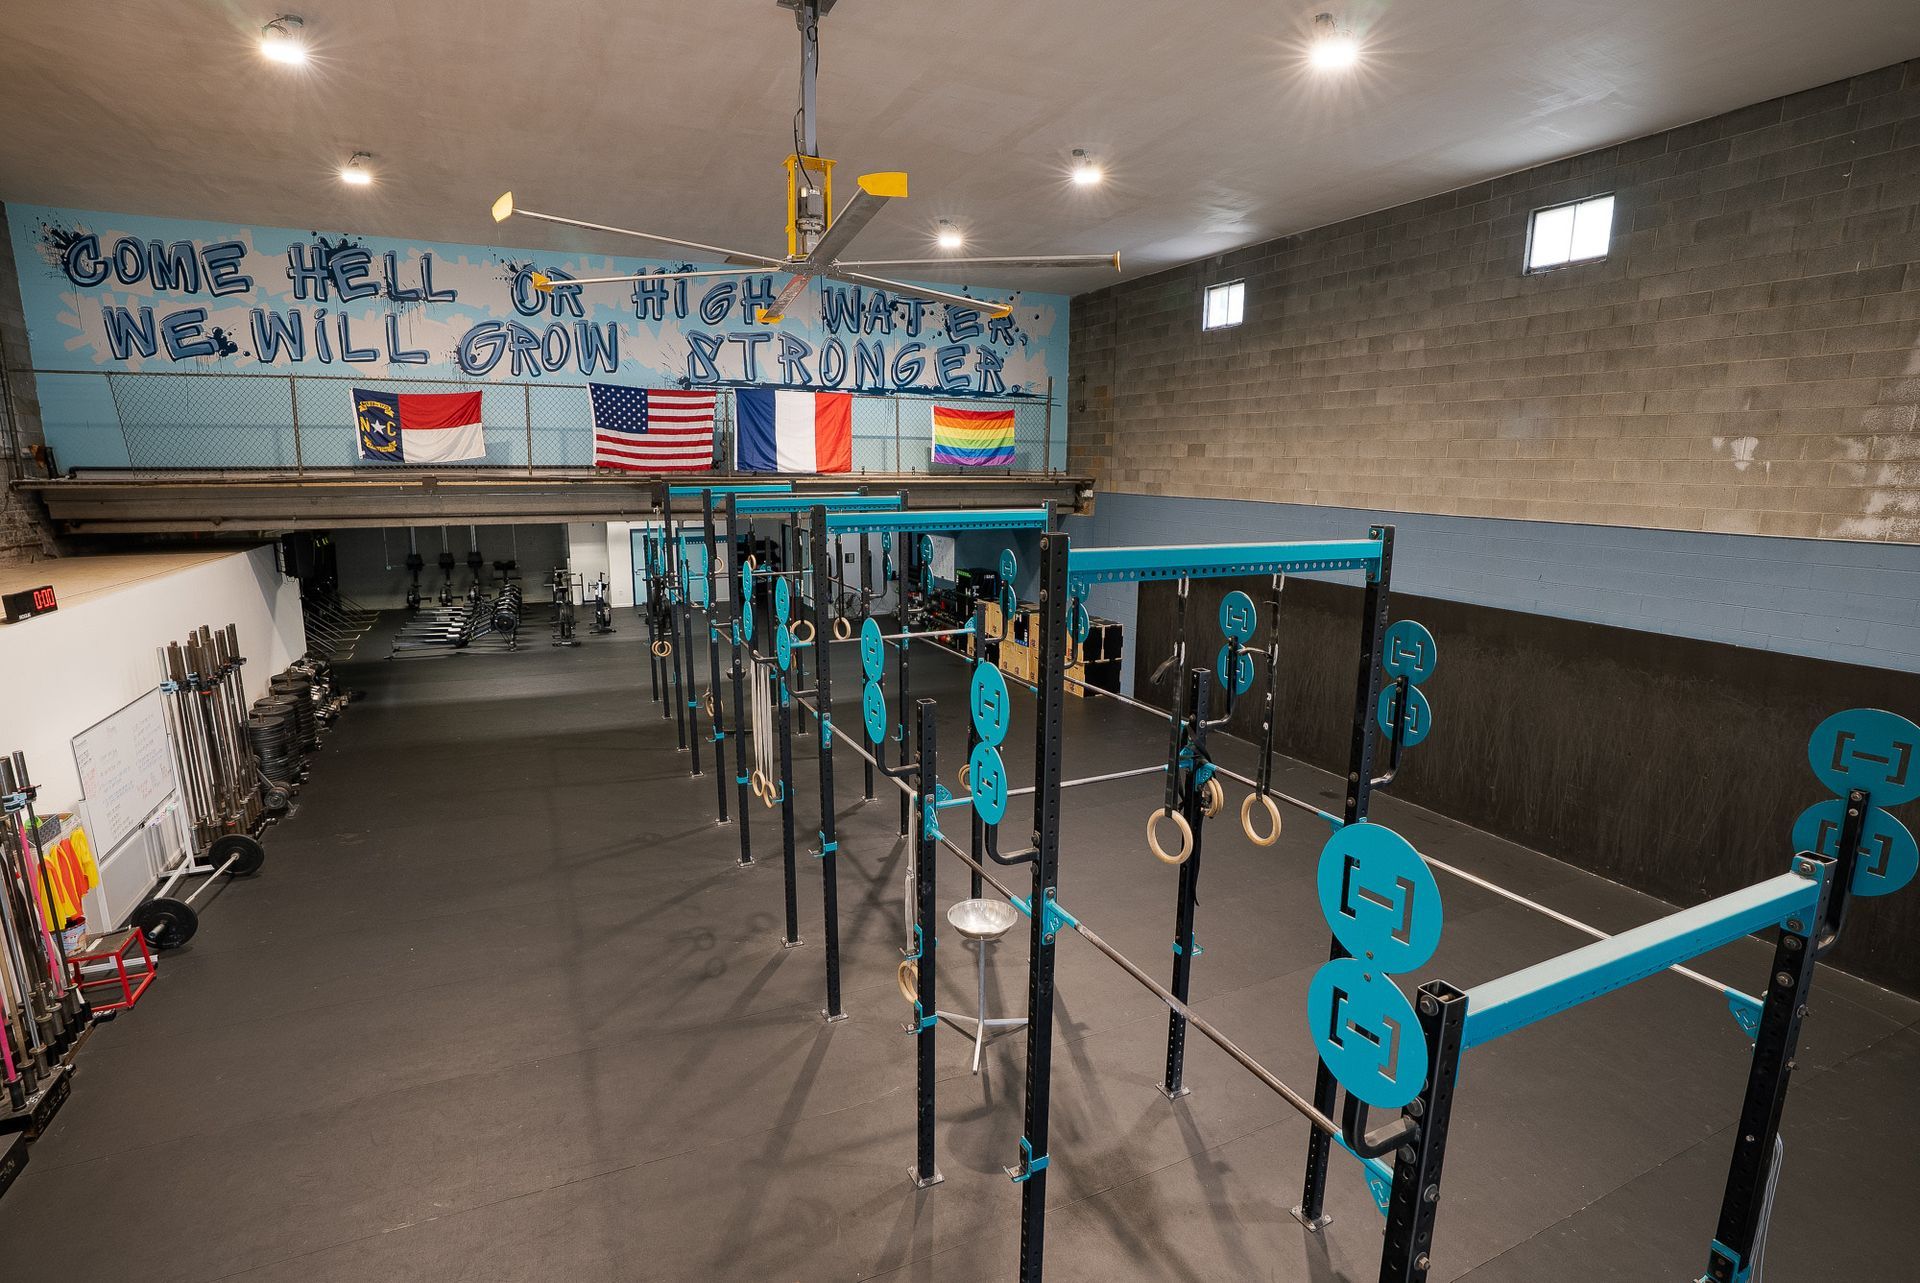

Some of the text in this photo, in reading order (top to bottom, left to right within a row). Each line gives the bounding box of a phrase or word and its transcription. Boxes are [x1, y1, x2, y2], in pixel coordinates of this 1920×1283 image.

[63, 233, 254, 298] COME
[286, 242, 458, 302] HELL
[510, 264, 586, 318] OR
[102, 306, 220, 362] WE
[458, 319, 620, 377] GROW
[359, 416, 397, 437] N C
[33, 588, 55, 610] 0:00
